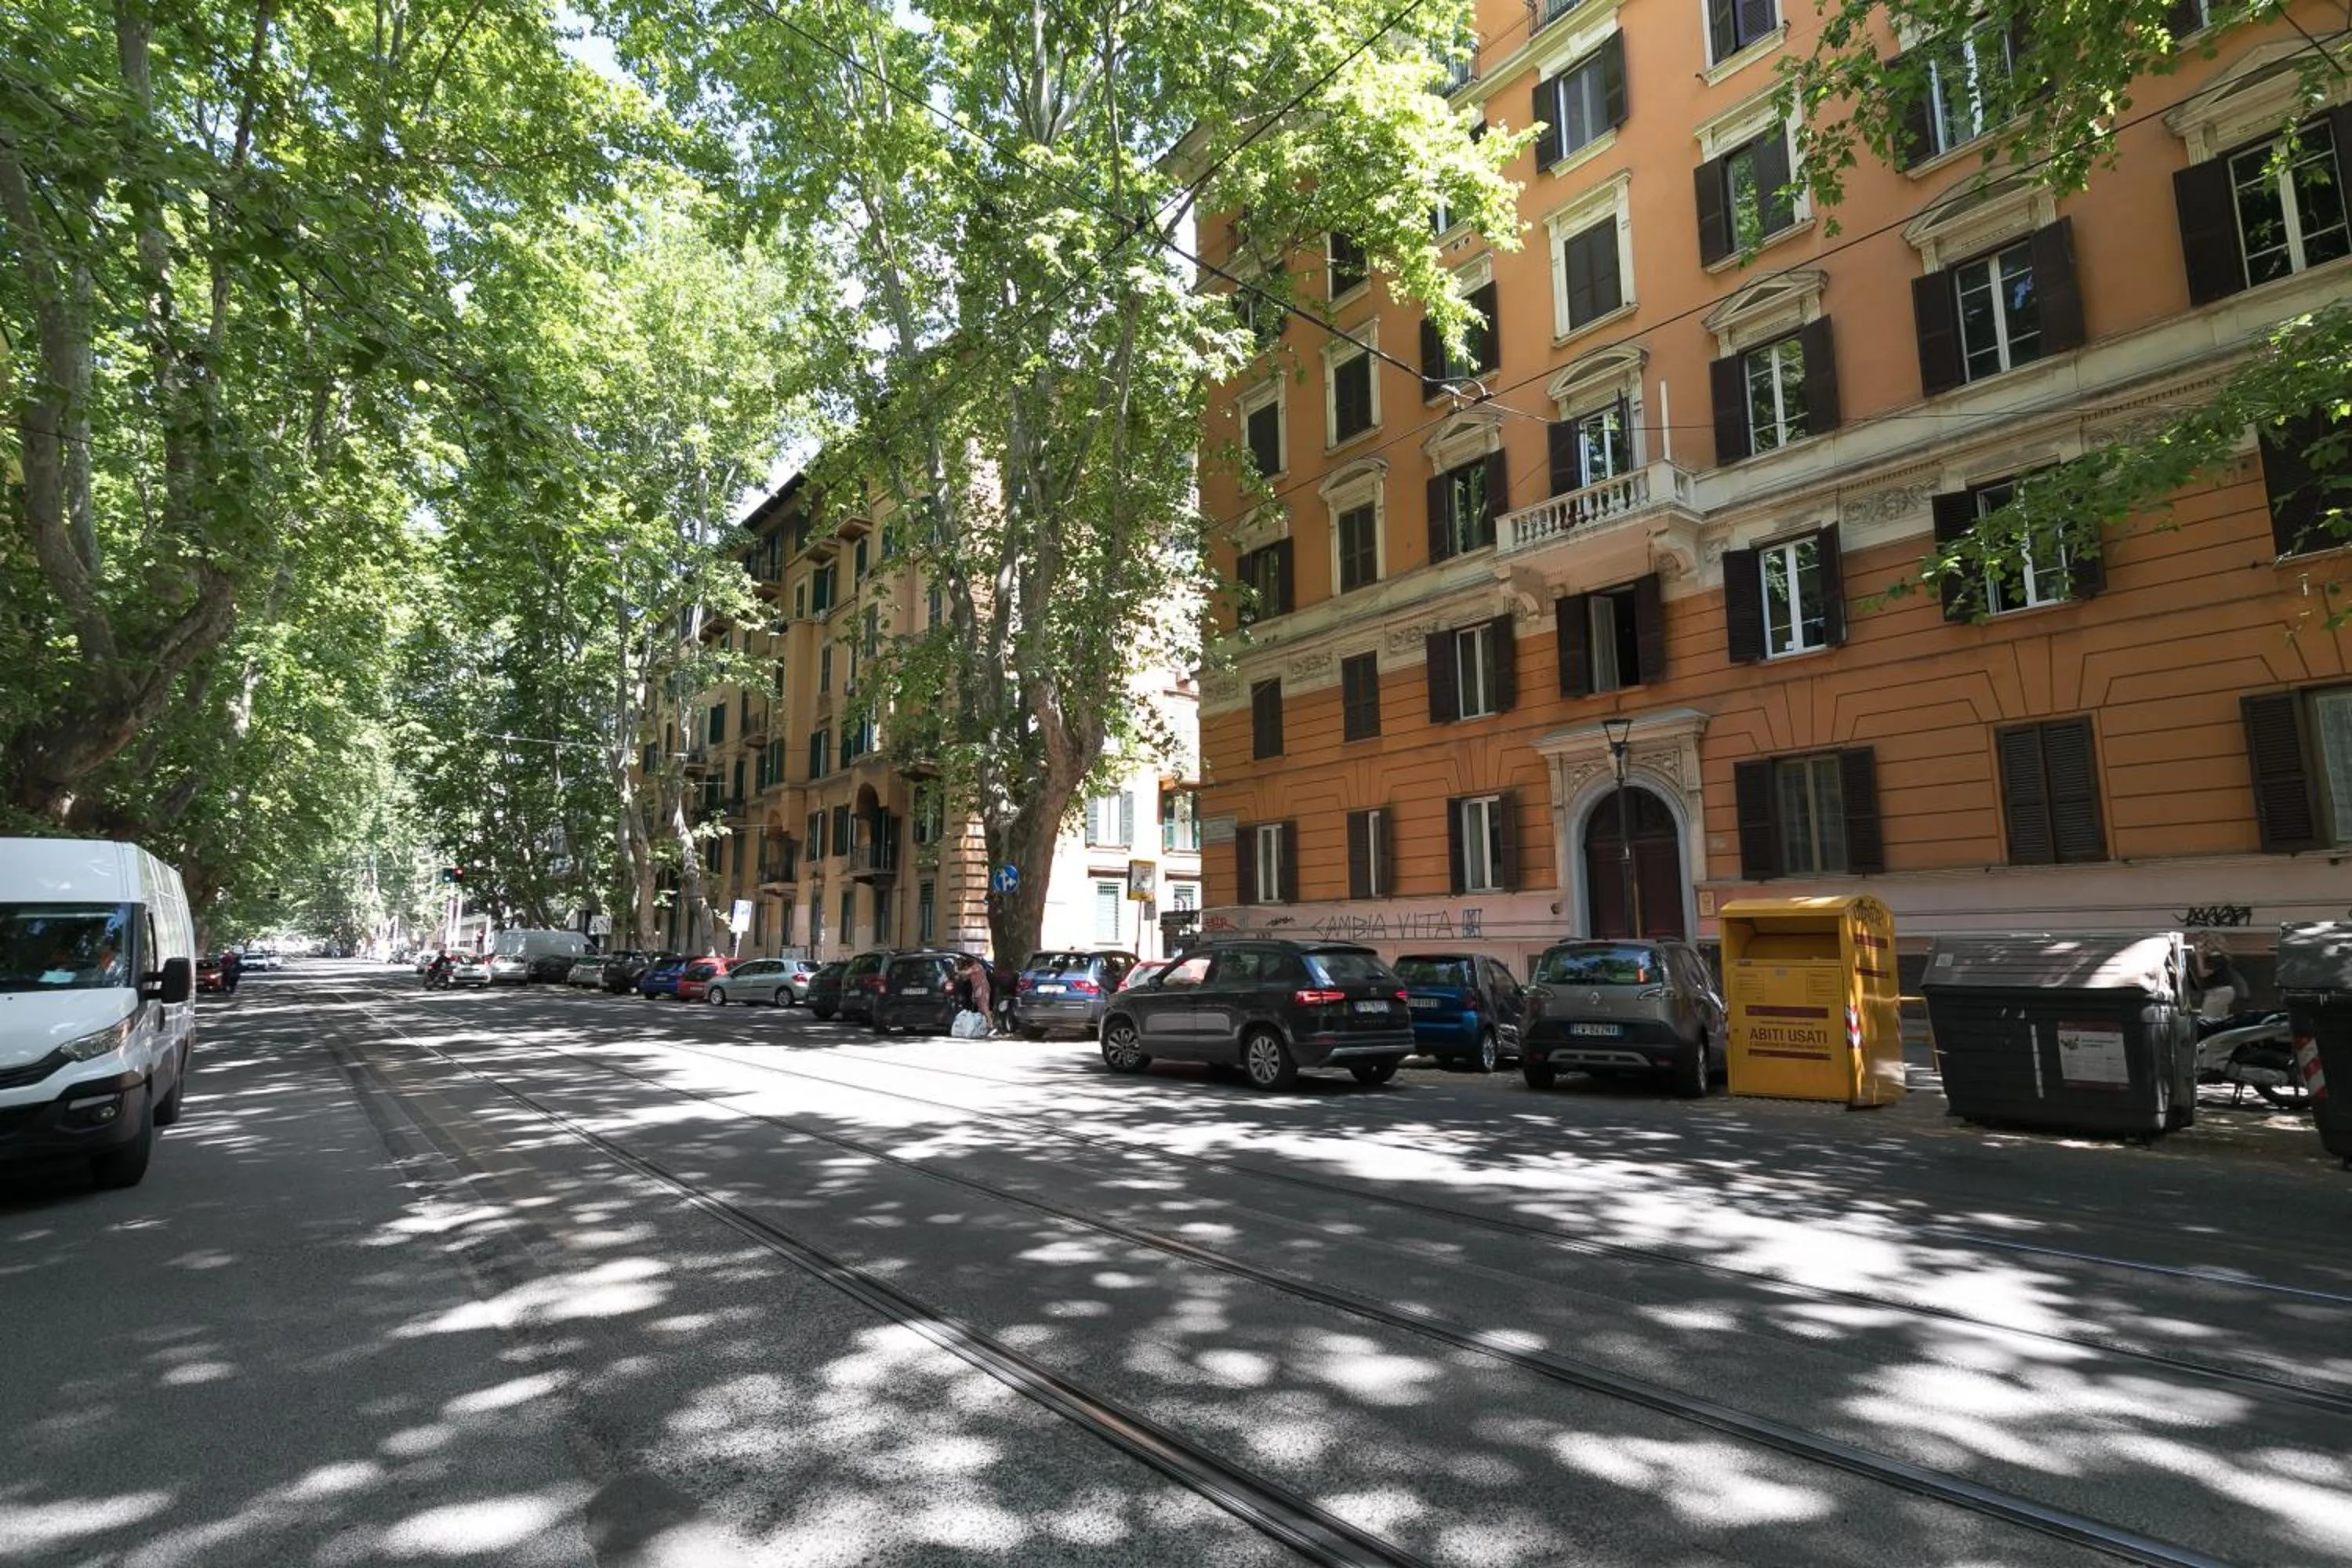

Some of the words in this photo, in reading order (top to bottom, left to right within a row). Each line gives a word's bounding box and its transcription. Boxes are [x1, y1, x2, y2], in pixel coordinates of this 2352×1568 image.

[1397, 909, 1454, 940] VITA
[1749, 1028, 1784, 1042] ABITI
[1788, 1029, 1828, 1044] USATI
